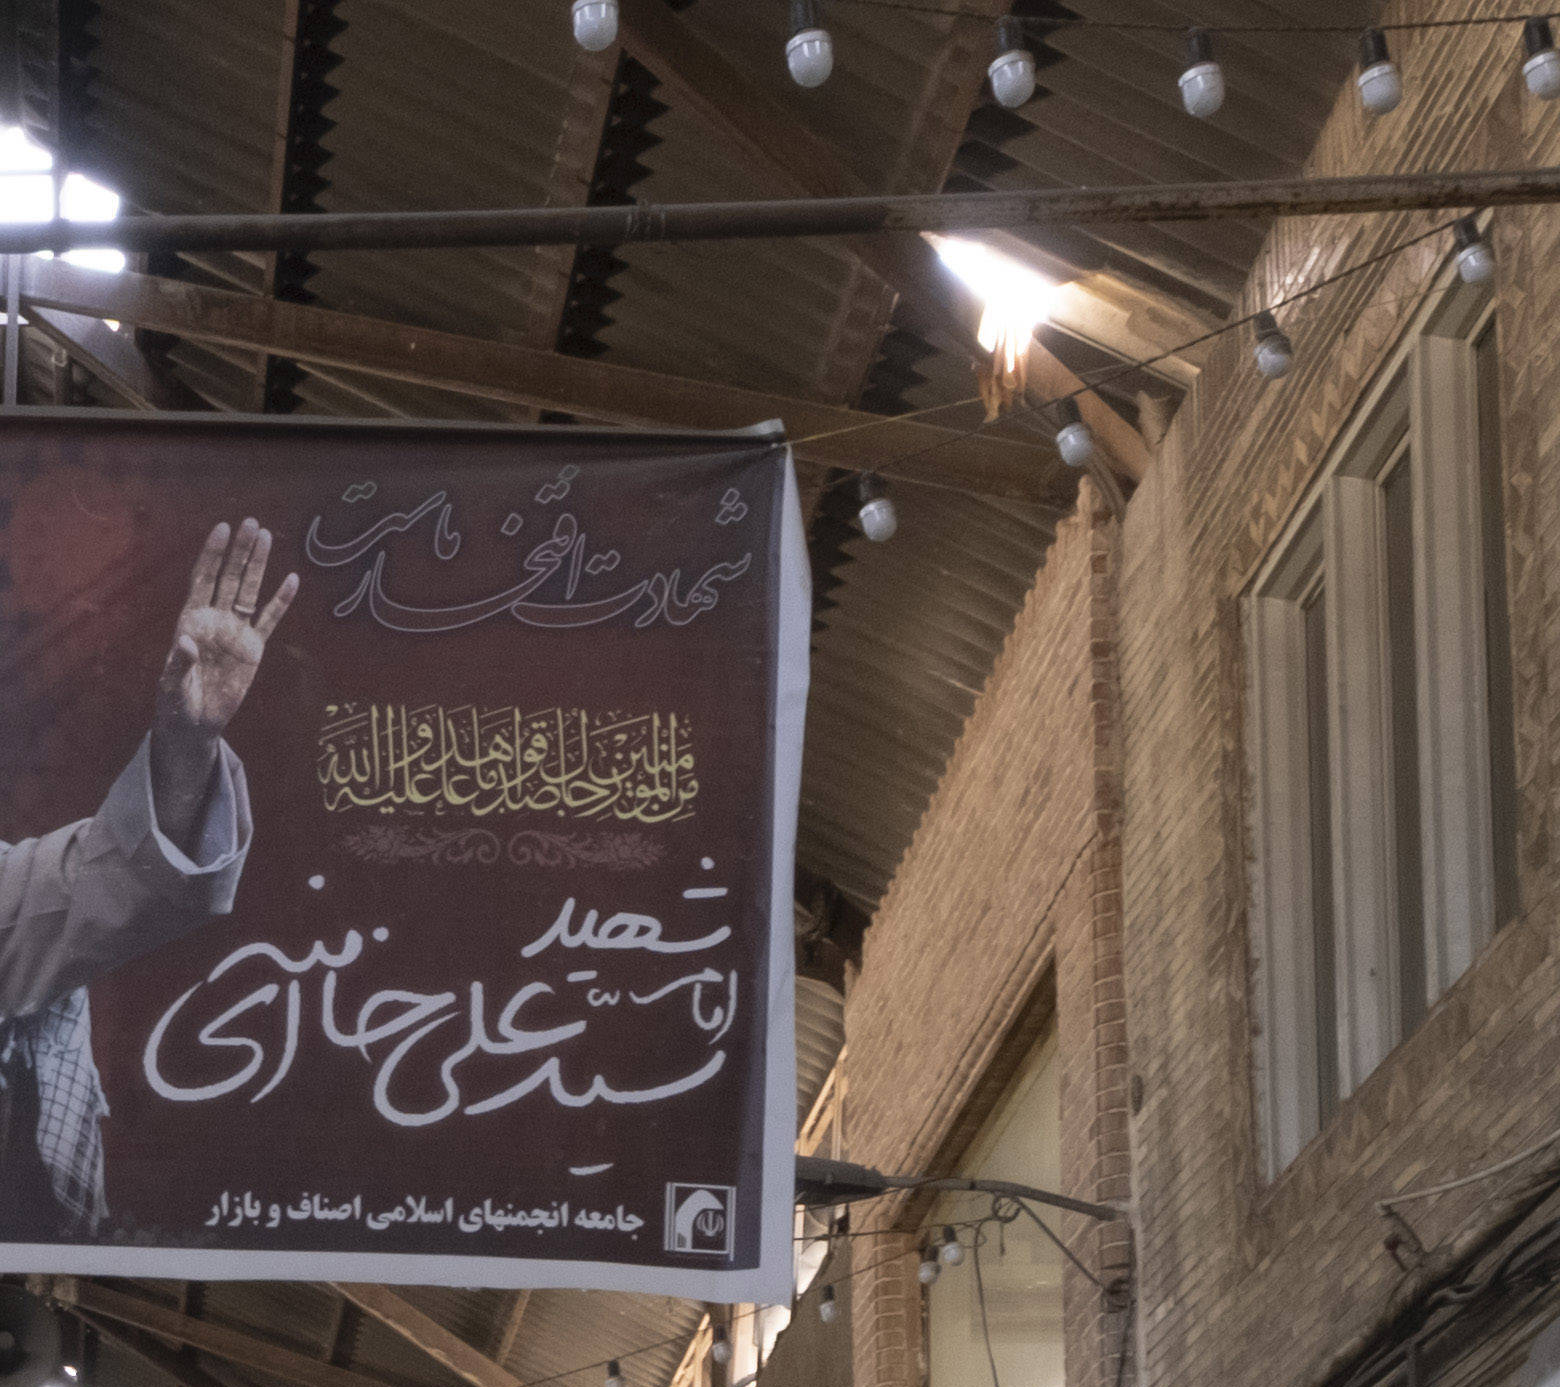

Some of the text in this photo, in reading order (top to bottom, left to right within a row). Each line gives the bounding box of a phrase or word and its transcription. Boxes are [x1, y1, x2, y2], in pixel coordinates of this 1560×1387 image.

[521, 856, 732, 958] شهید
[373, 981, 589, 1127] علی
[204, 1190, 645, 1241] جامعه انجمنهای اسلامی اصناف و بازار
